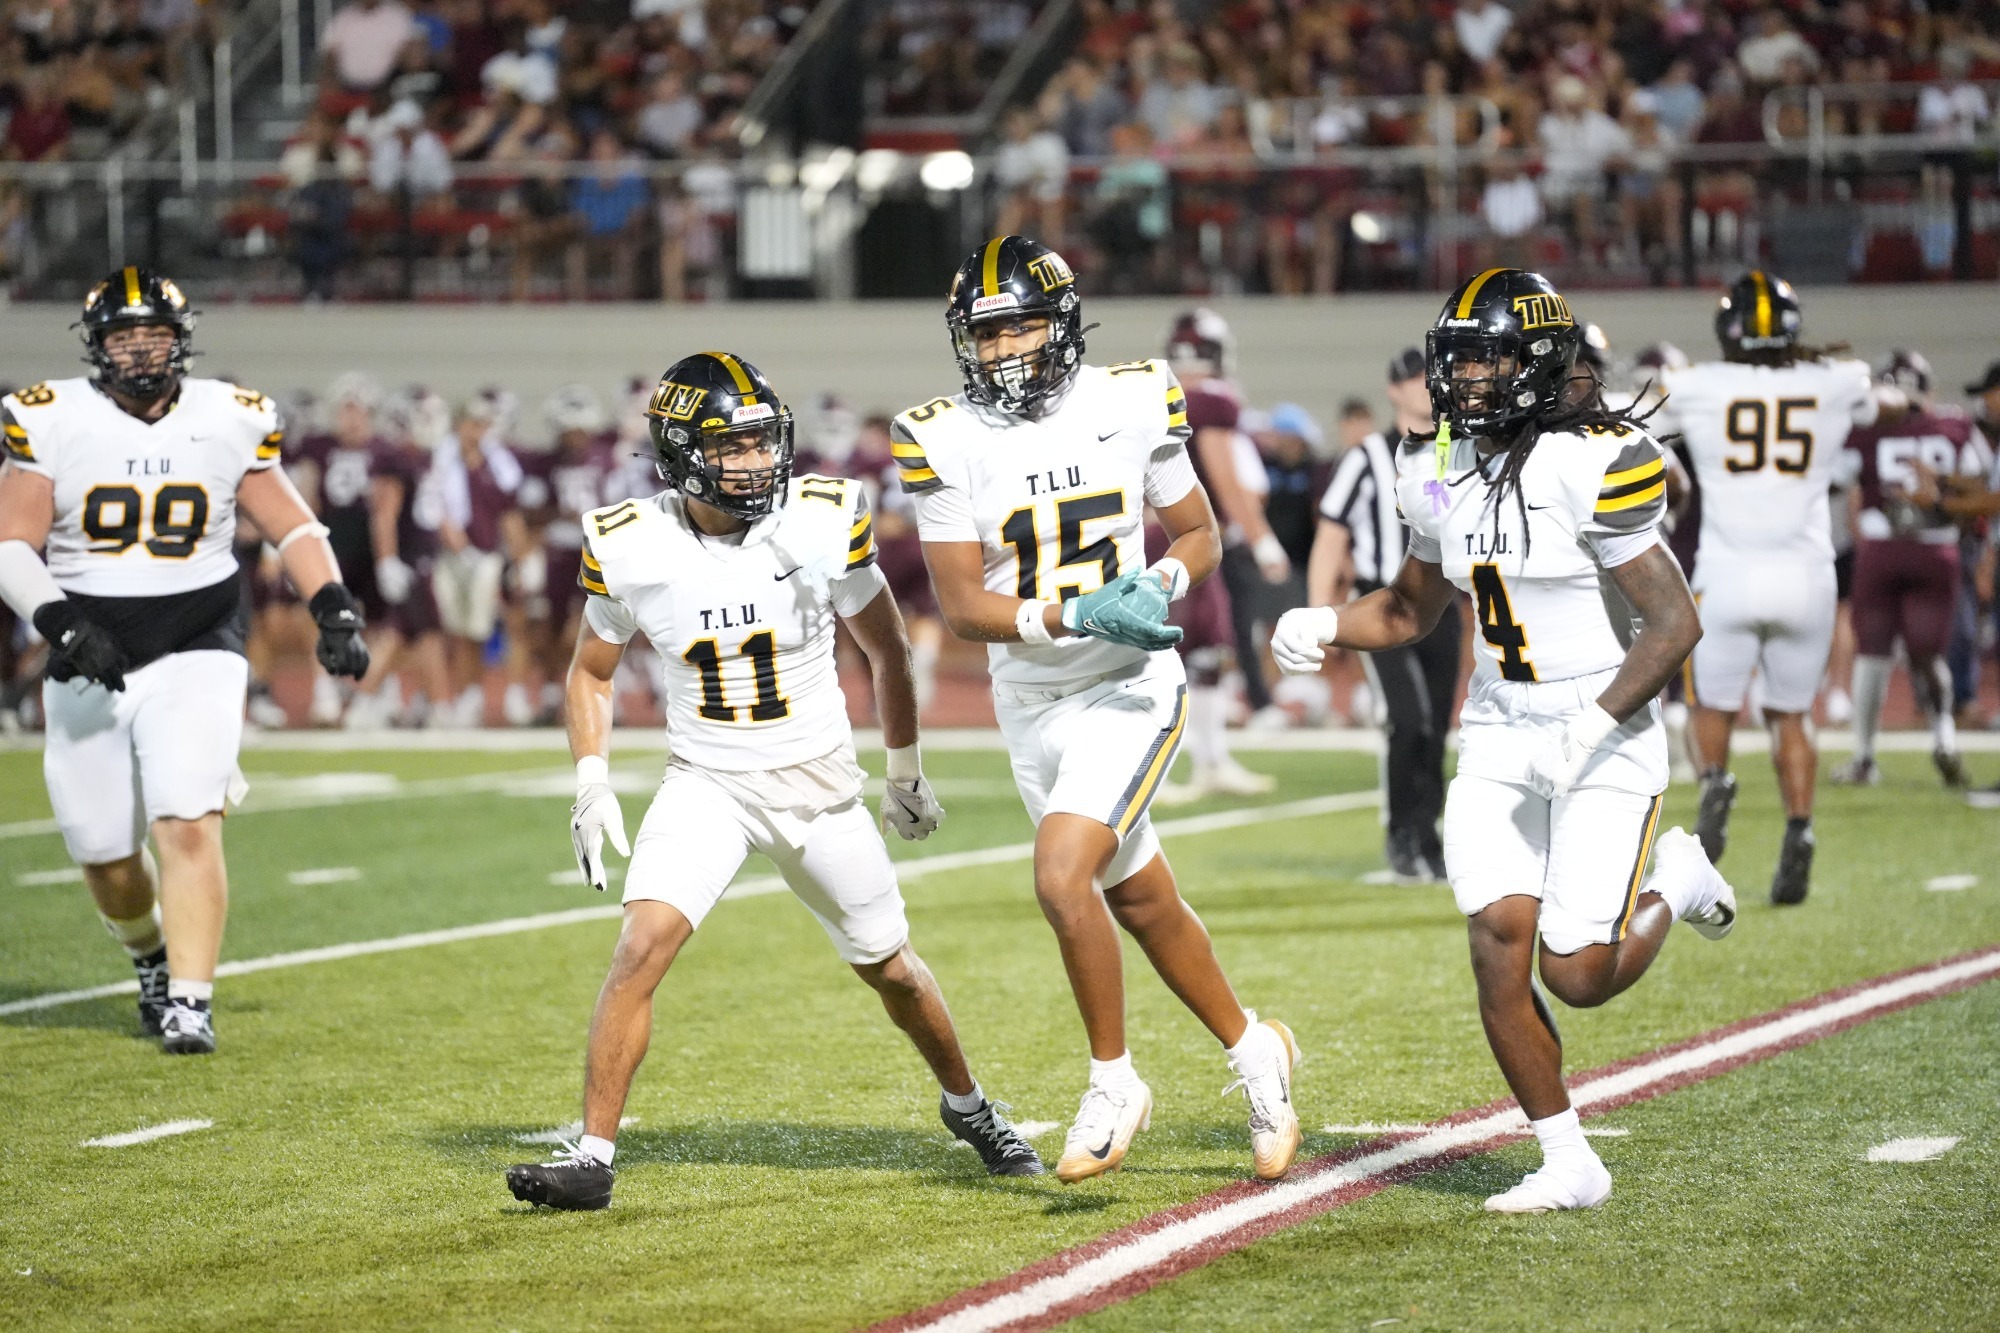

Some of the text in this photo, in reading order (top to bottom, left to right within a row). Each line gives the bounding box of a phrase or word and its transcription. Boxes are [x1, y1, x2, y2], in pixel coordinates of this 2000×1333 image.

[1028, 252, 1074, 292] TL
[976, 296, 1010, 308] Riddell
[1447, 319, 1480, 327] Riddell
[738, 405, 770, 417] Riddell
[1725, 397, 1818, 478] 95
[126, 459, 175, 477] T.L.U.
[1026, 465, 1087, 496] T.L.U.
[801, 478, 846, 508] 11
[82, 483, 209, 560] 99
[594, 502, 638, 536] 11
[1000, 488, 1127, 604] 15
[1465, 533, 1512, 555] T.LU.
[700, 603, 762, 630] T.L.U.
[1470, 562, 1540, 682] 4
[683, 629, 791, 723] 11
